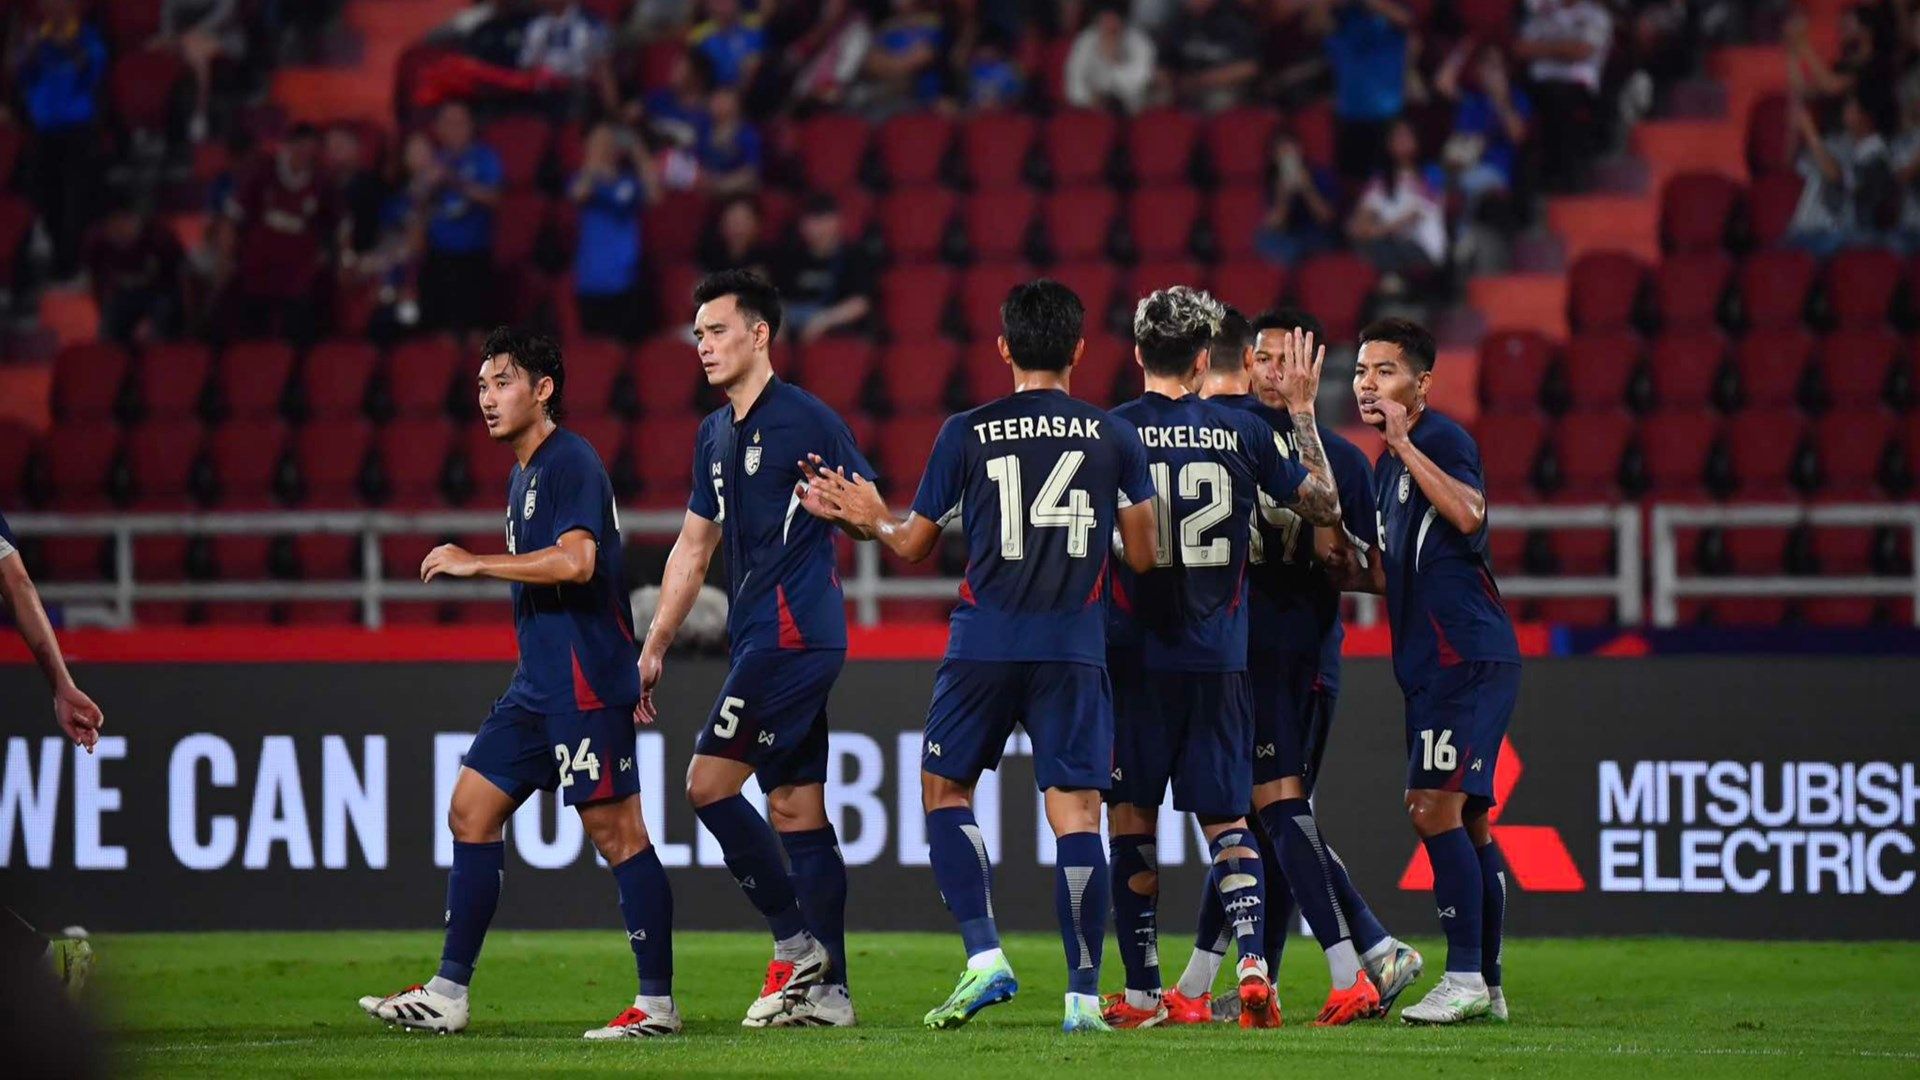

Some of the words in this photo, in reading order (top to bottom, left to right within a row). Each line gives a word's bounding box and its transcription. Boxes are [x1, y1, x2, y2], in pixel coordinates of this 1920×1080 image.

[974, 415, 1100, 445] TEERASAK
[986, 450, 1097, 560] 14
[714, 695, 745, 739] 5
[555, 737, 601, 787] 24
[1421, 729, 1457, 771] 16
[0, 735, 128, 870] WE
[168, 732, 389, 870] CAN
[1600, 828, 1916, 895] ELECTRIC
